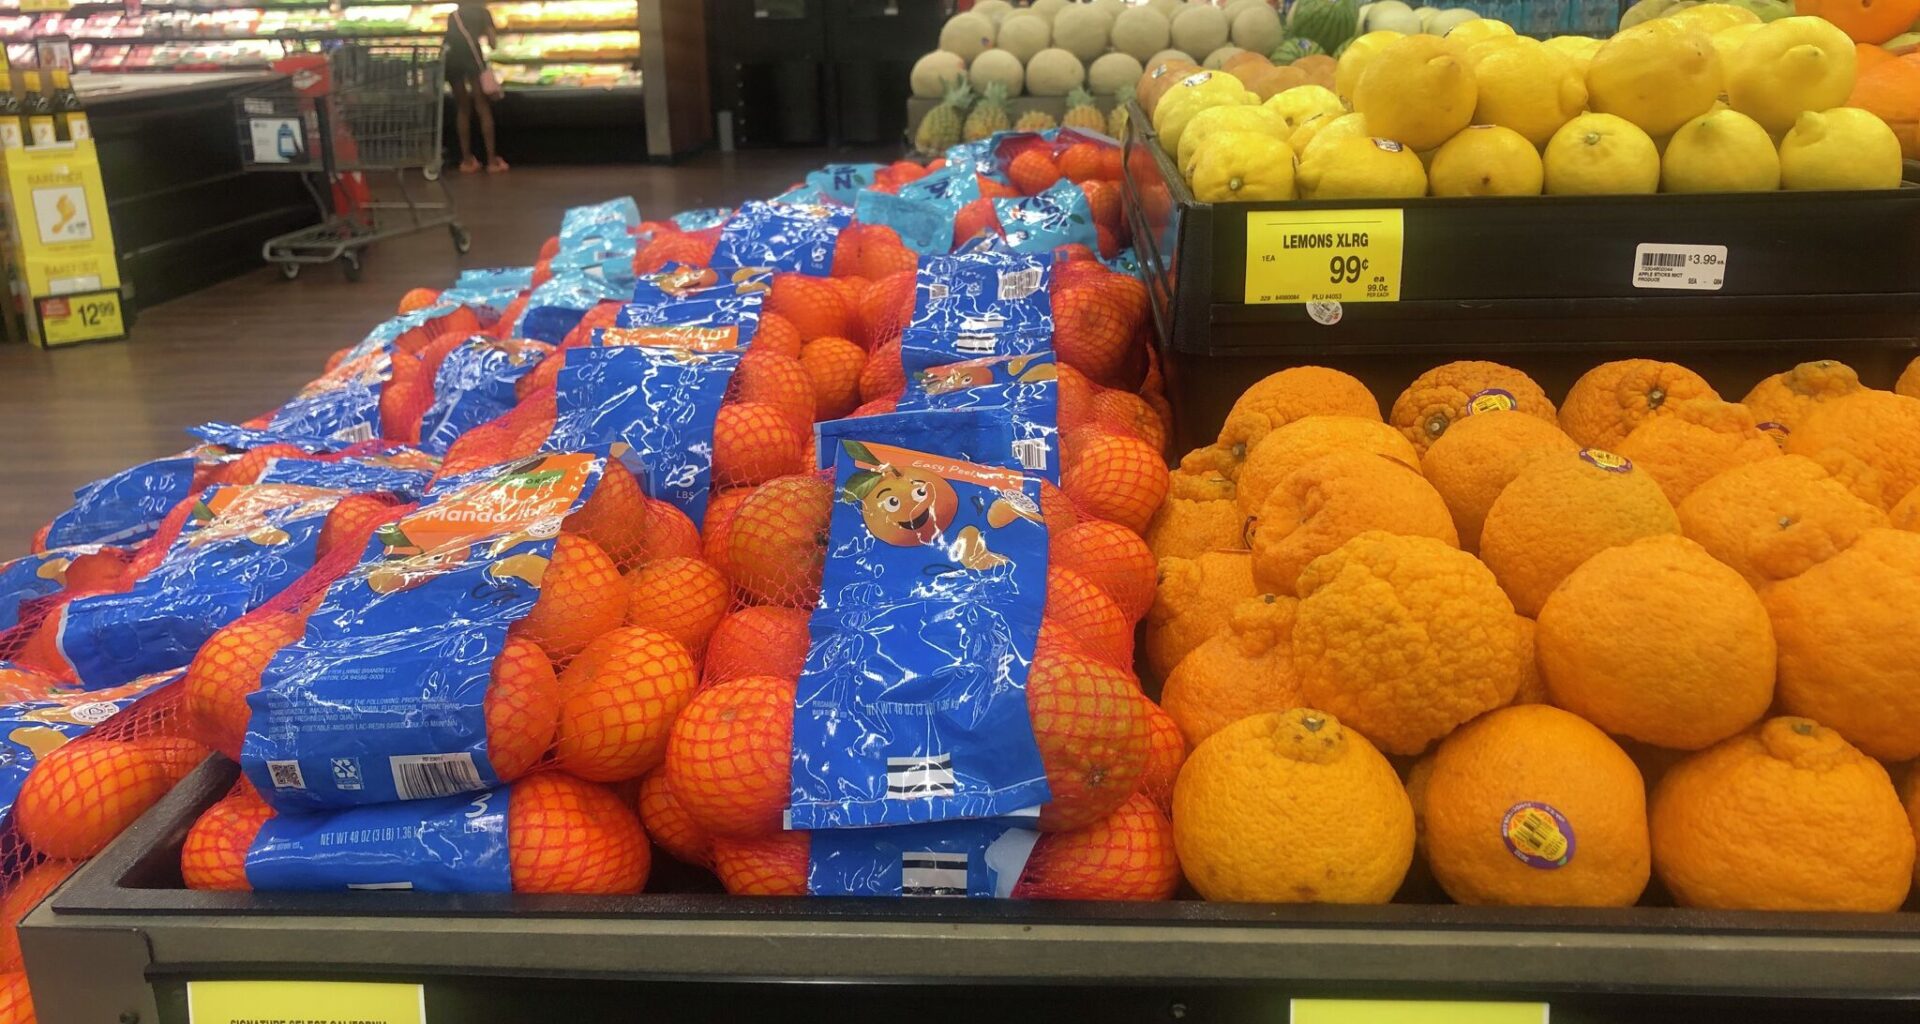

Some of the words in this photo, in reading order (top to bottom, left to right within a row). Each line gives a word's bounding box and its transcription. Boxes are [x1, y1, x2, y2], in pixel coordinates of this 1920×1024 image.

[1283, 234, 1333, 249] LEMONS
[1336, 232, 1369, 248] XLRG
[1688, 254, 1717, 265] $3.99
[912, 460, 945, 473] Easy
[320, 833, 334, 846] NET
[336, 831, 348, 845] WT
[350, 831, 359, 844] 48
[361, 829, 371, 843] OZ
[372, 829, 380, 843] (3
[381, 827, 394, 842] LB)
